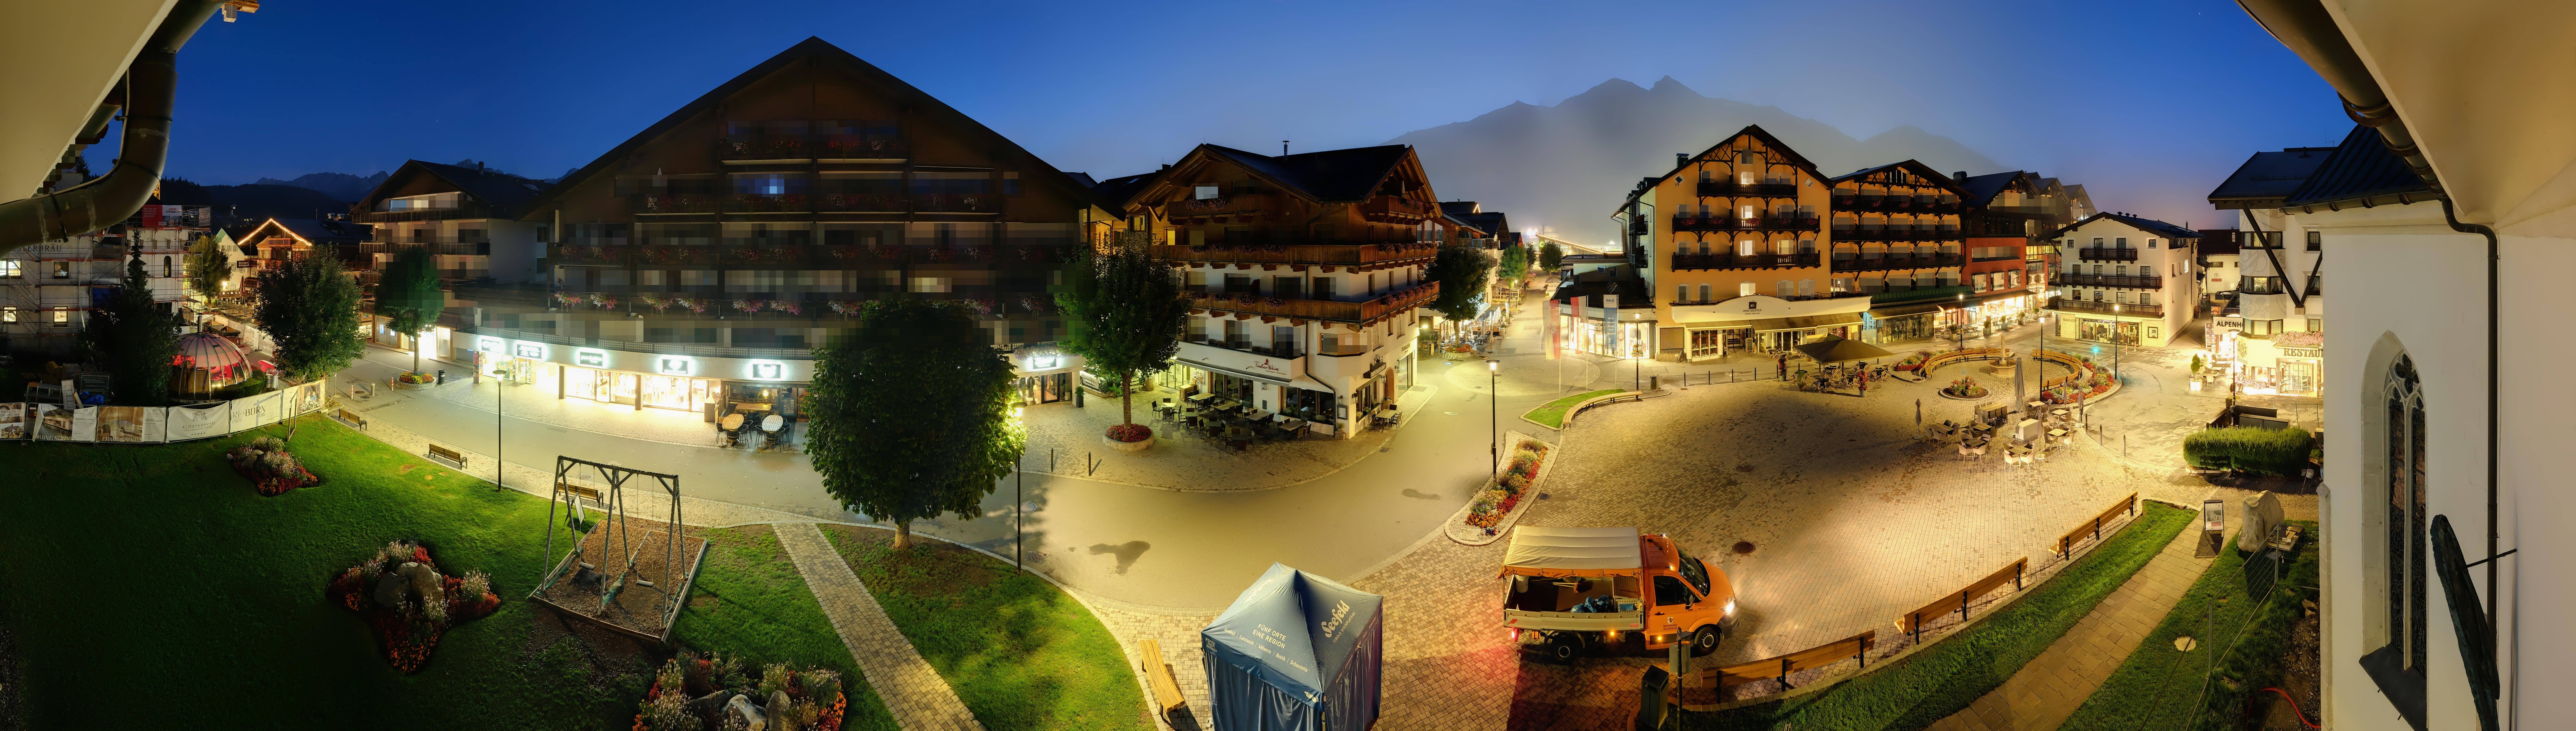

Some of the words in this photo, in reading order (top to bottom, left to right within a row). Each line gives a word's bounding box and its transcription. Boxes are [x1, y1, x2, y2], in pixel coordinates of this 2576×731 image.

[1371, 364, 1385, 377] RESTAURANT
[1321, 599, 1350, 638] Seefeld
[1333, 632, 1342, 643] TIROLS
[1341, 611, 1355, 633] HOCHPLATEAU
[1252, 629, 1265, 639] EINE
[1265, 635, 1285, 649] REGION
[1258, 624, 1272, 633] FÜNF
[1272, 631, 1286, 641] ORTE
[1206, 644, 1217, 653] plateau
[1224, 627, 1235, 636] Seefeld
[1239, 635, 1254, 645] Leutasch
[1258, 644, 1271, 654] Mösern
[1276, 653, 1286, 661] Reith
[1290, 660, 1308, 673] Scharnitz
